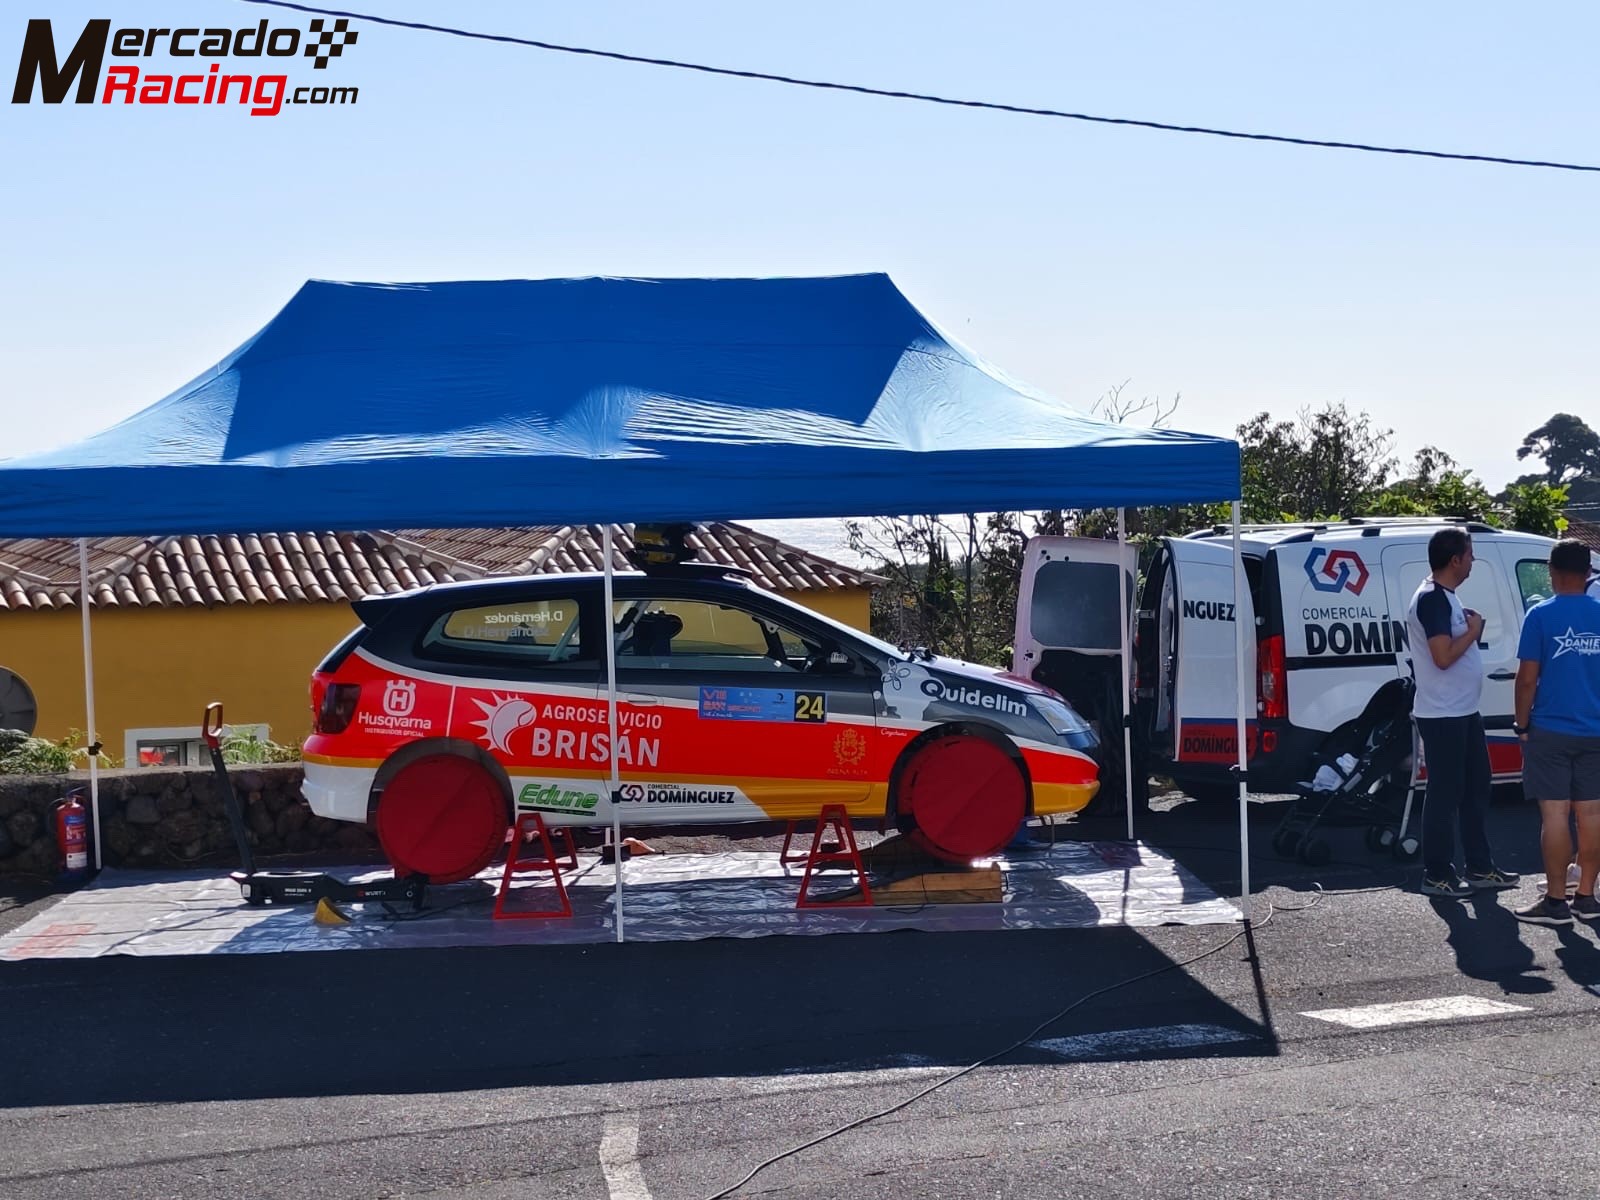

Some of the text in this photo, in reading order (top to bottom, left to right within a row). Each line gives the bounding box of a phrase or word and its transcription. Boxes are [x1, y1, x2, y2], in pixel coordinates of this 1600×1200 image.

[1302, 606, 1376, 620] COMERCIAL
[795, 694, 824, 720] 24
[920, 679, 1028, 717] Quidelim
[358, 711, 432, 730] Husqvarna
[542, 703, 662, 730] AGROSEVICIO
[531, 727, 661, 768] BRISÁN
[517, 783, 599, 809] Edune
[647, 788, 735, 804] DOMÍNGUEZ
